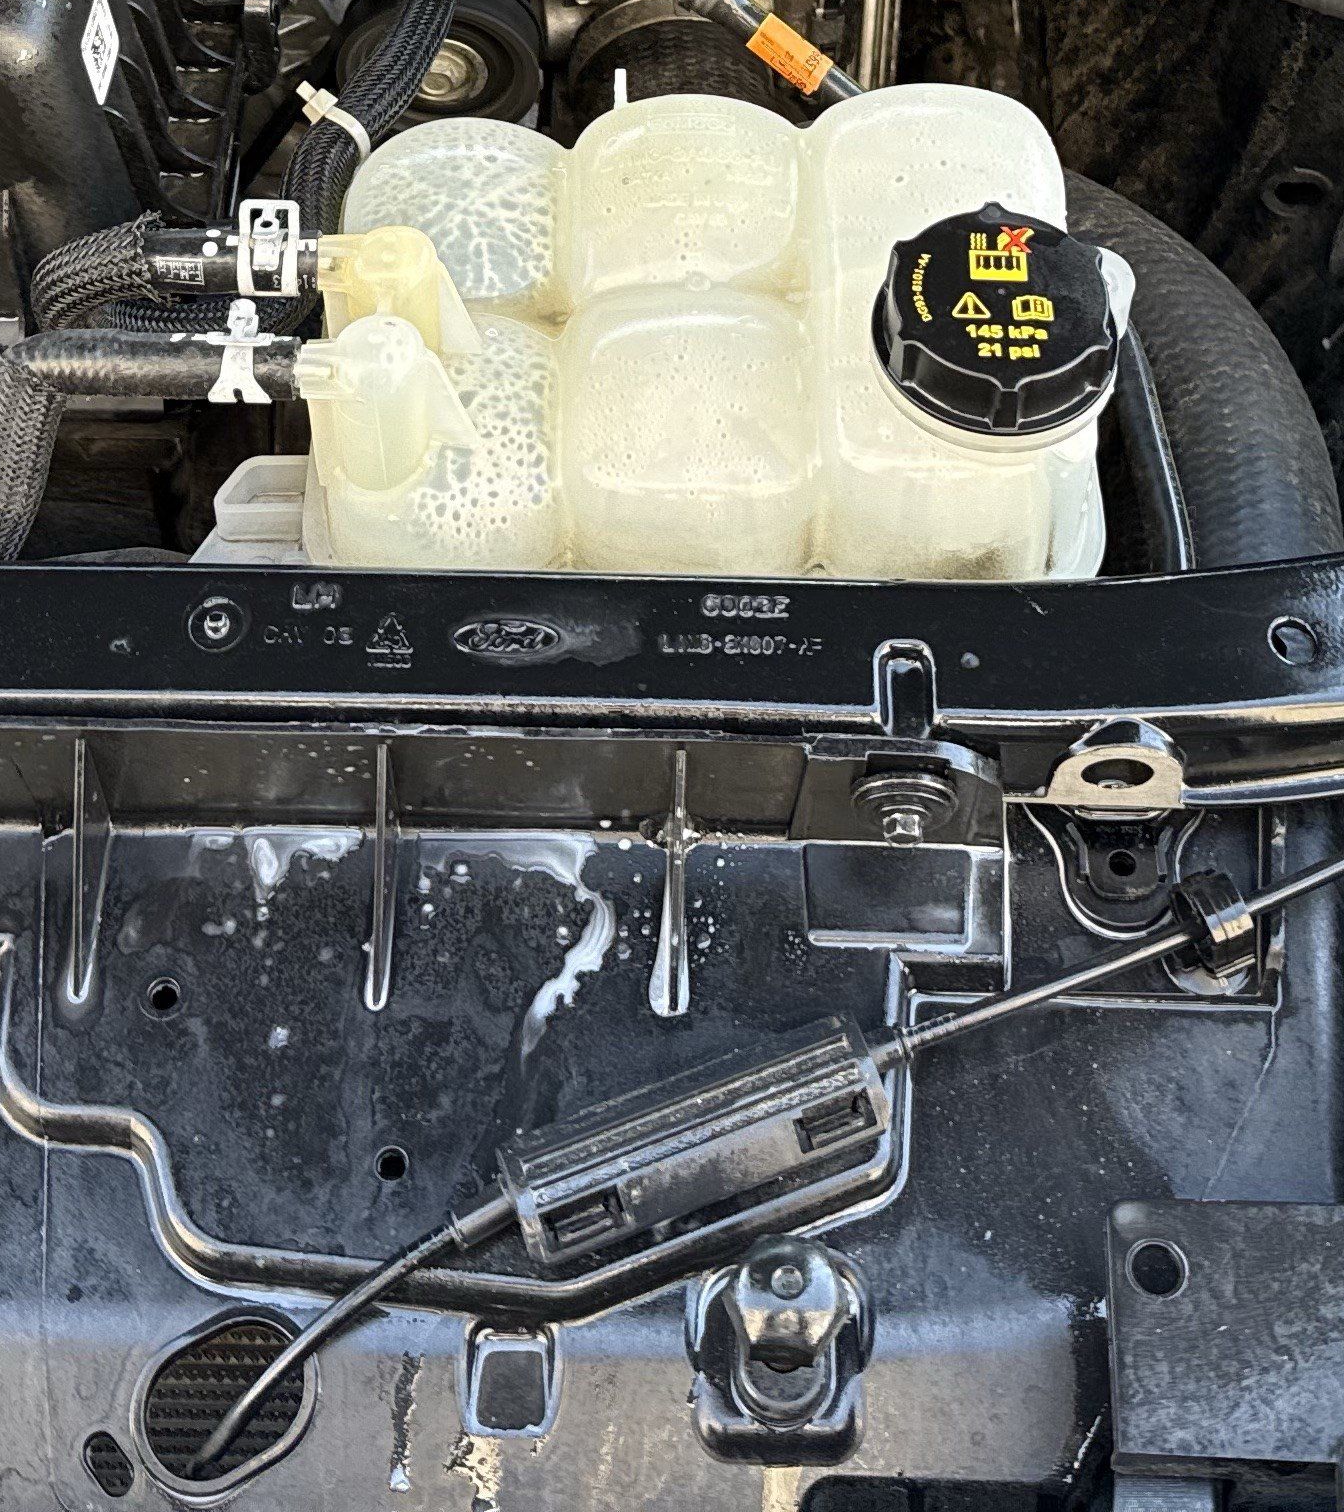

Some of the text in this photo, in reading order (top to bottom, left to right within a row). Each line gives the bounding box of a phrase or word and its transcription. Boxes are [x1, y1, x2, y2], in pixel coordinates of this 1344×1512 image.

[965, 324, 1049, 340] 145 kPa
[977, 342, 1041, 361] 21 psi
